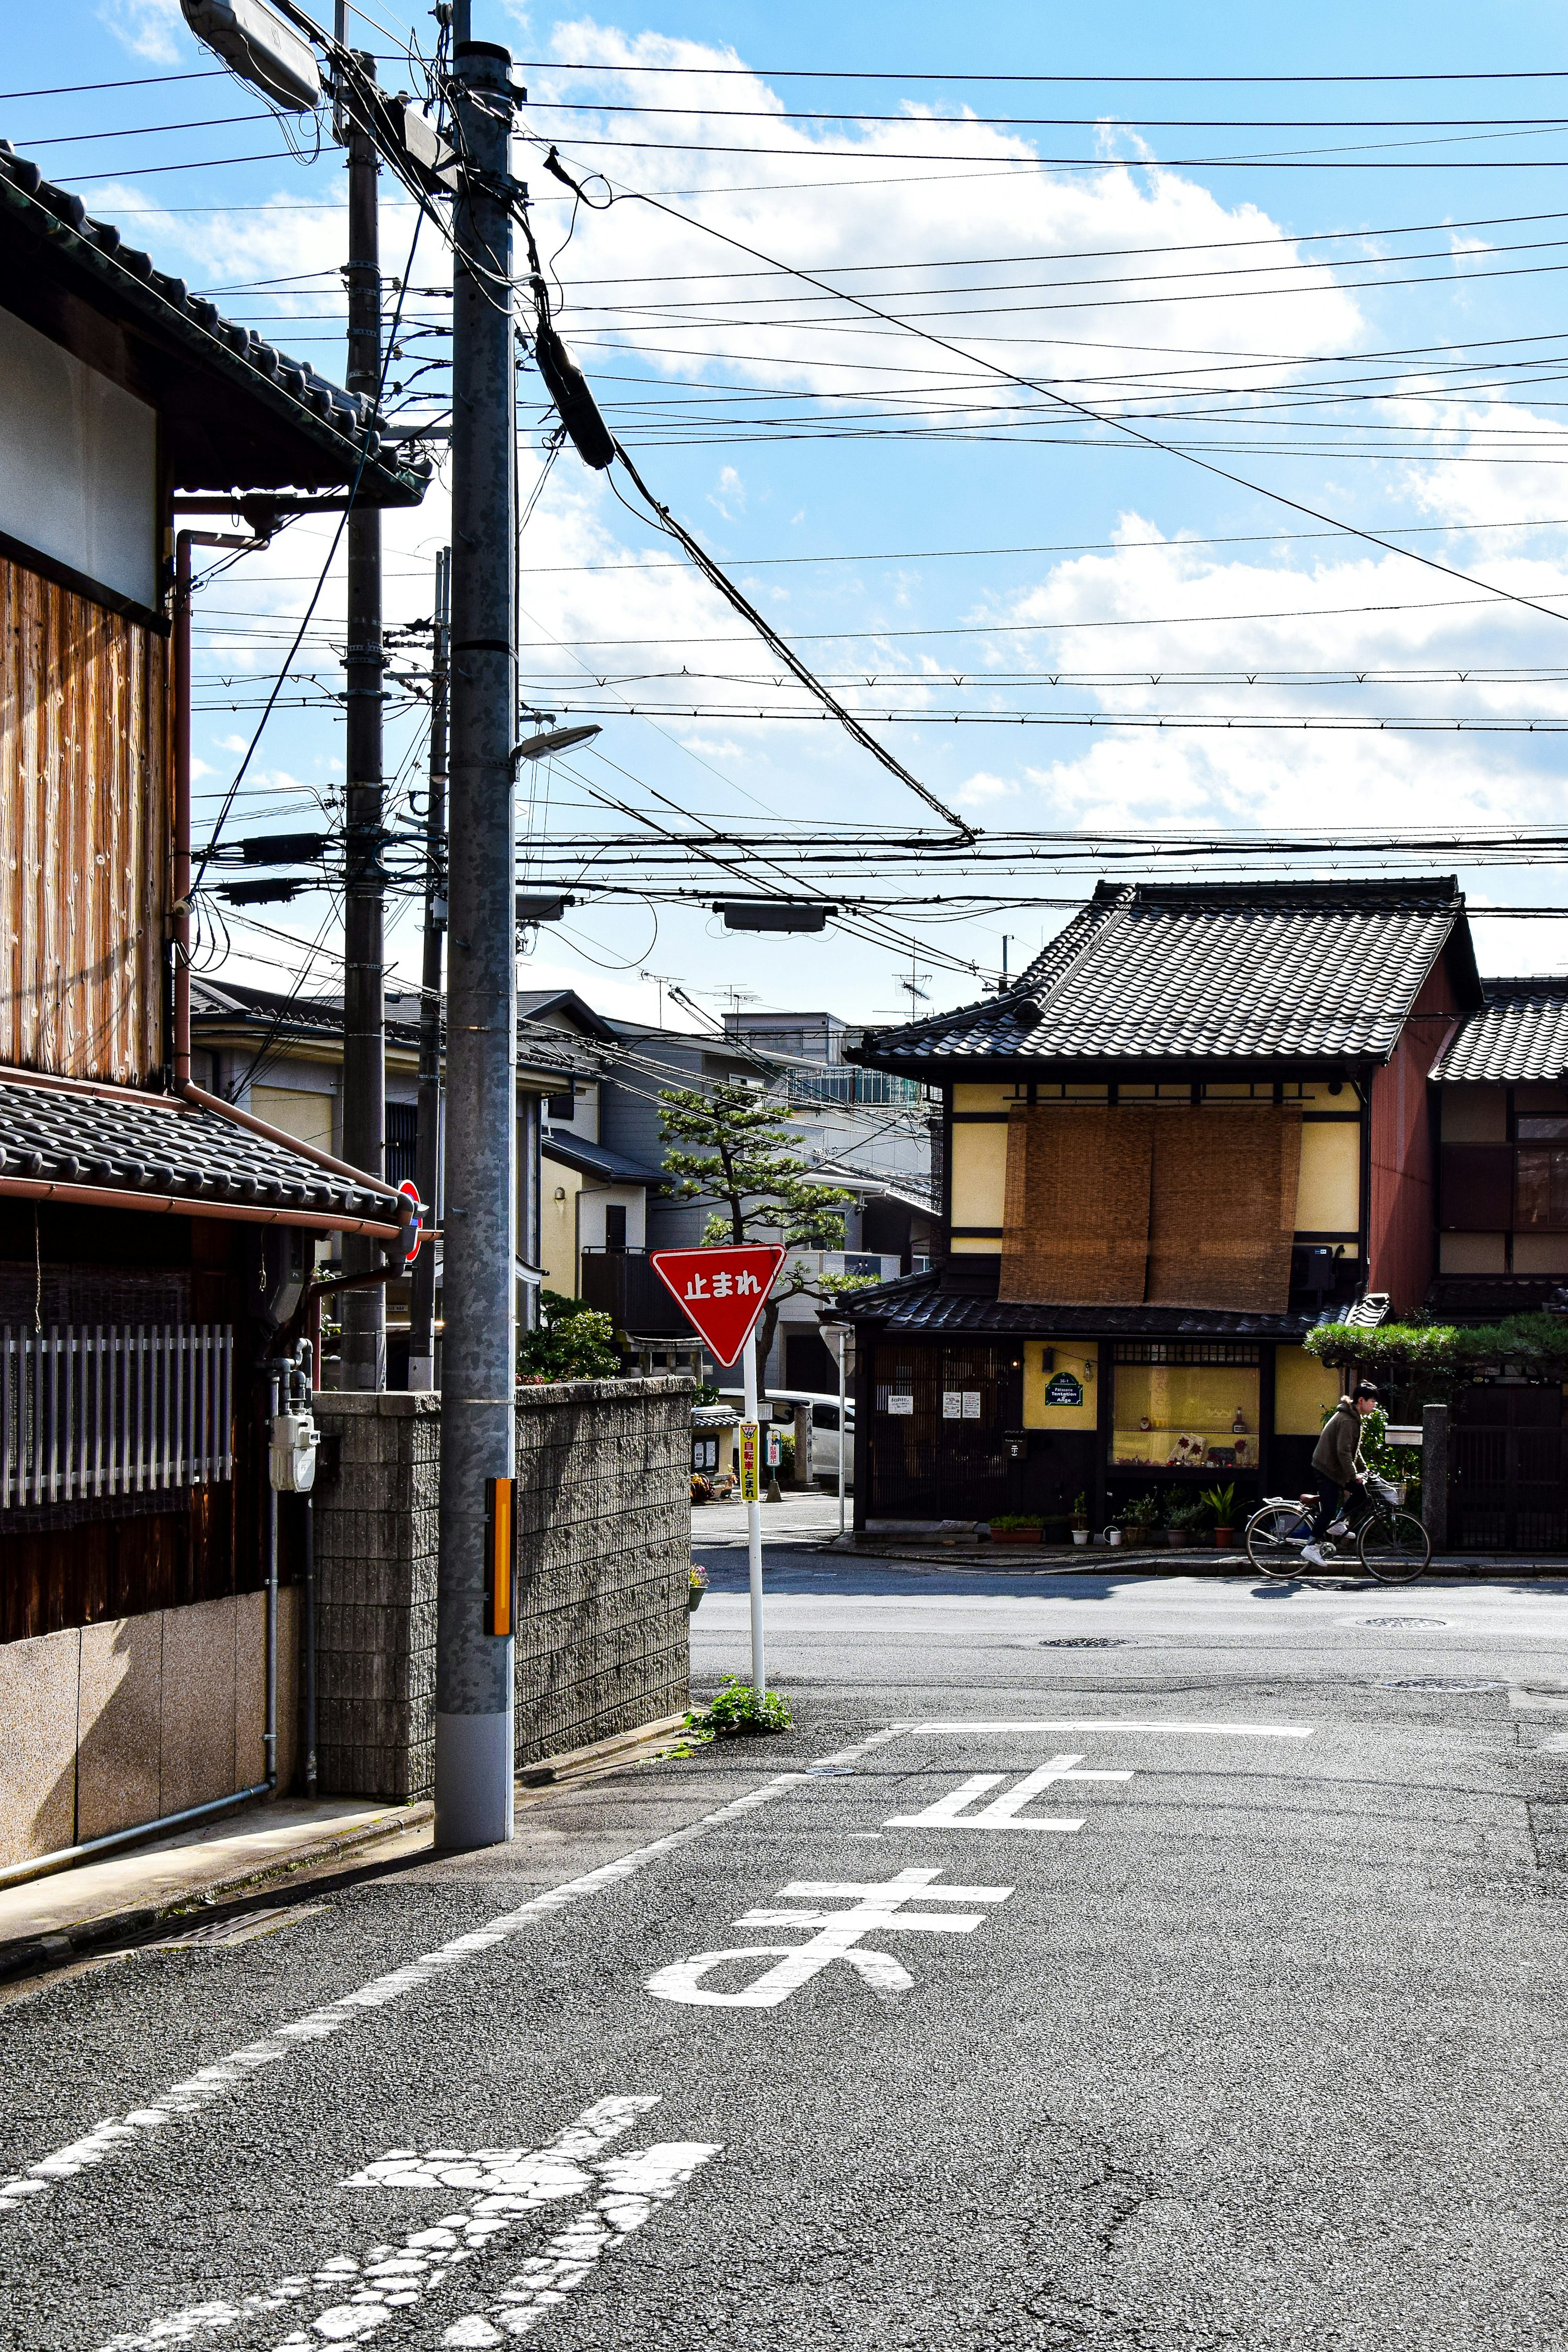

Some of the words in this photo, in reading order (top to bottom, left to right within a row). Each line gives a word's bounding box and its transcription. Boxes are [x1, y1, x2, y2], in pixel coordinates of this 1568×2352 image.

[684, 1270, 762, 1300] 止まれ
[744, 1441, 754, 1498] 自転車とまれ
